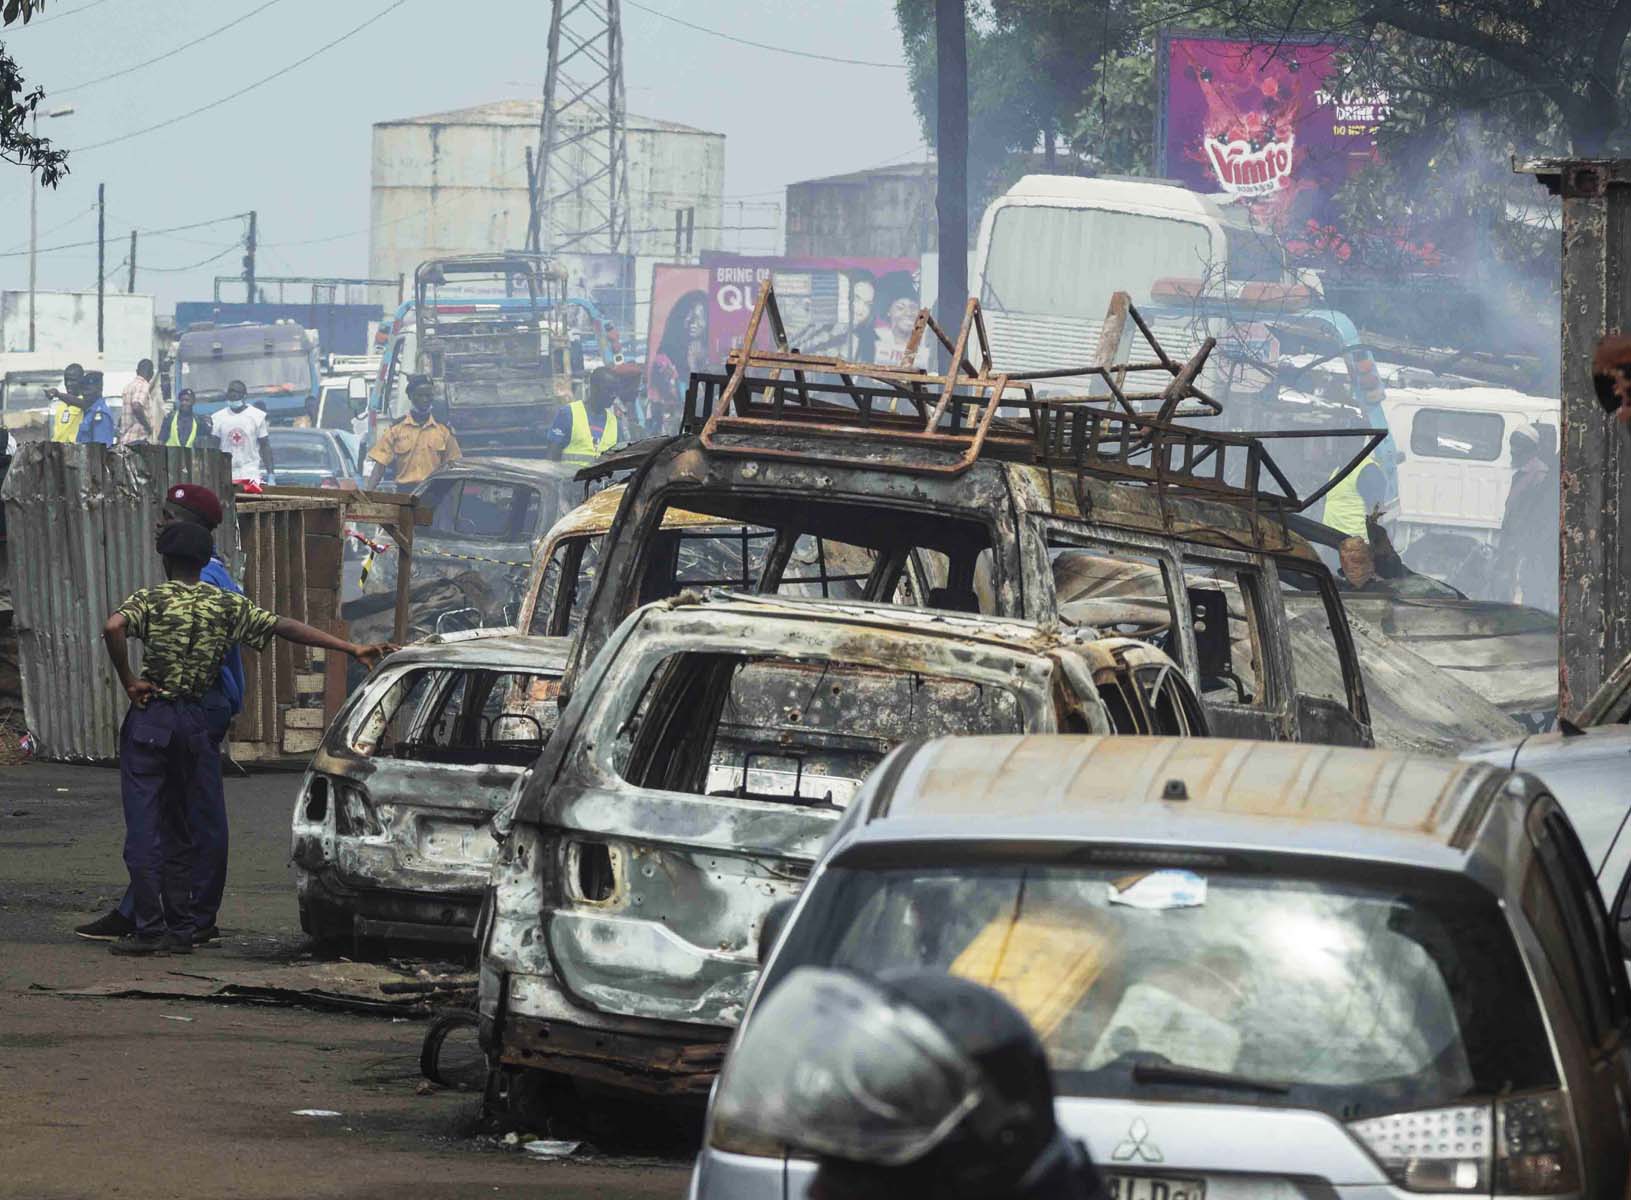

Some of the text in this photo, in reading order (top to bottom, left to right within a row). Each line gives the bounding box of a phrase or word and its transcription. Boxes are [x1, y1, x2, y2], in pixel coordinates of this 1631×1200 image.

[1336, 106, 1374, 121] DRINK
[1210, 143, 1289, 185] Vimto
[717, 267, 753, 283] BRING
